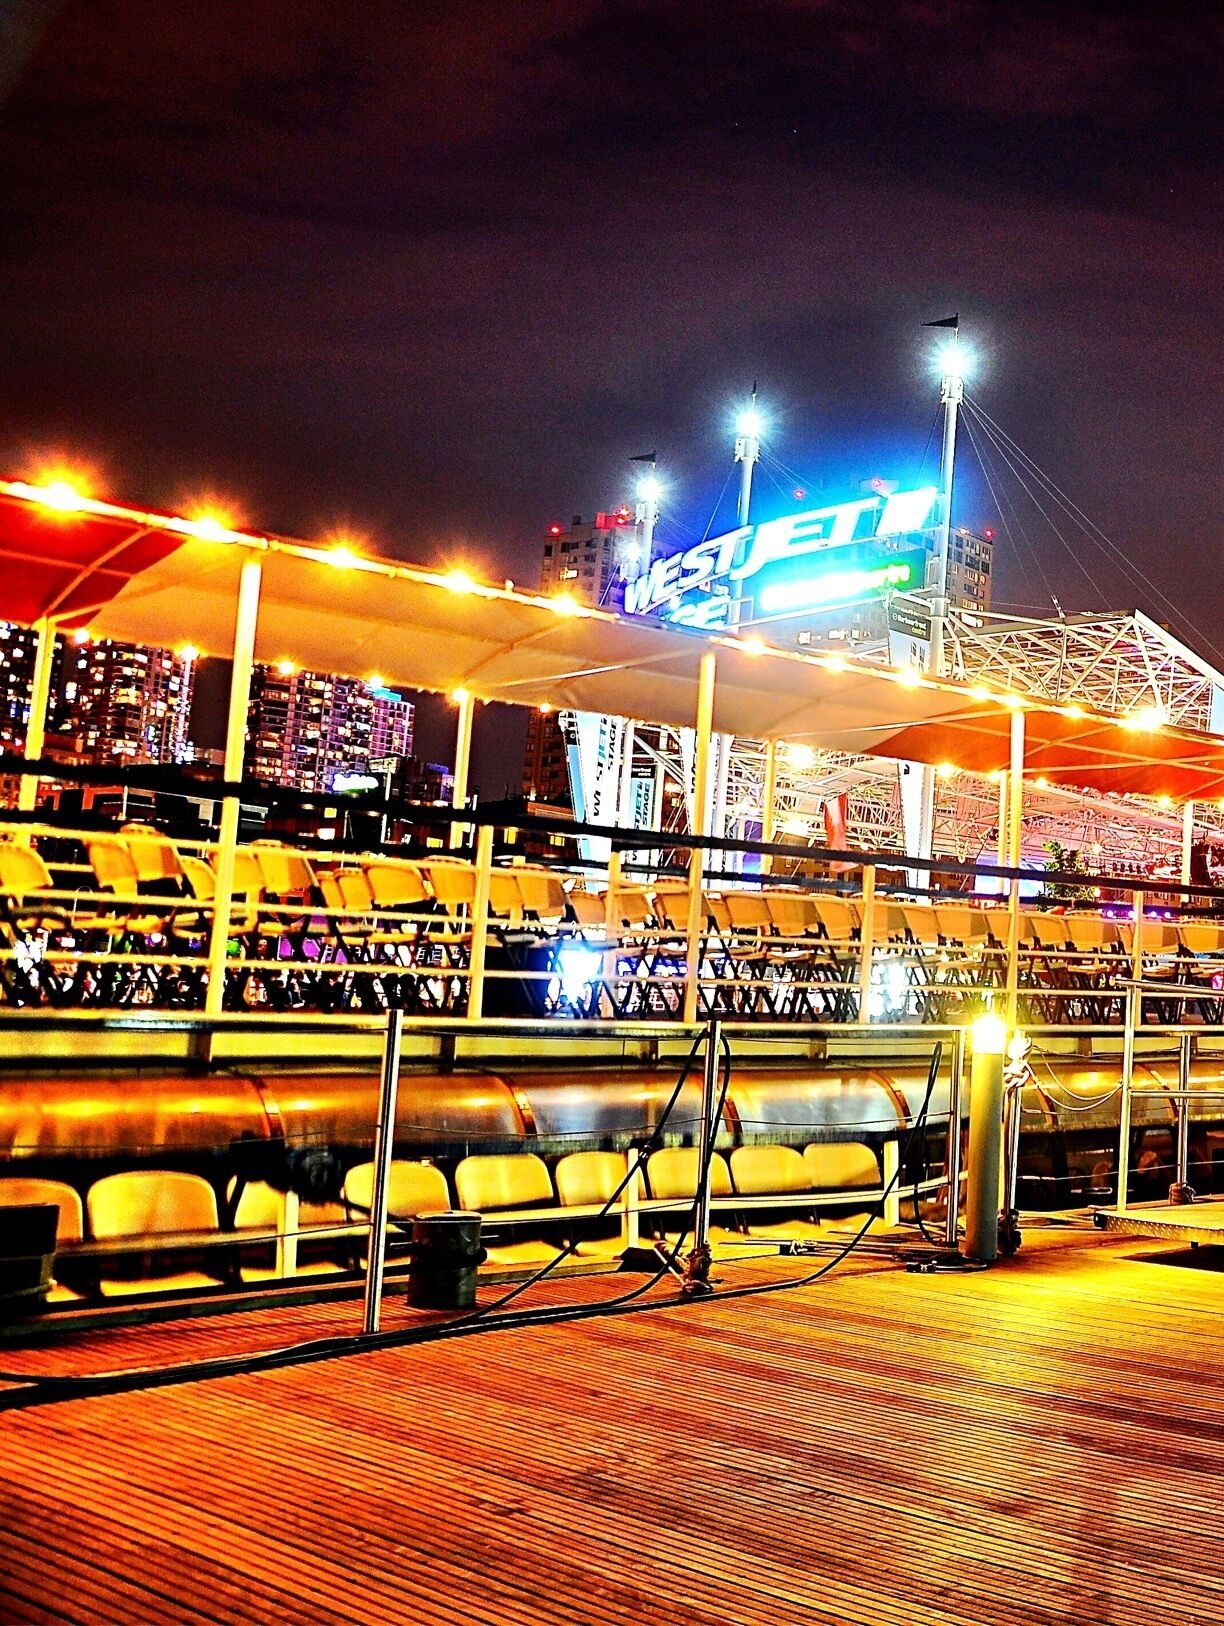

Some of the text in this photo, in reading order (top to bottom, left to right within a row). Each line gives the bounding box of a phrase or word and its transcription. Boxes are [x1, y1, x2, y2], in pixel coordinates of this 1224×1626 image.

[624, 496, 881, 615] WESTJET
[593, 724, 607, 817] WSTJET
[607, 718, 617, 771] STAGE
[642, 782, 651, 827] STAGE
